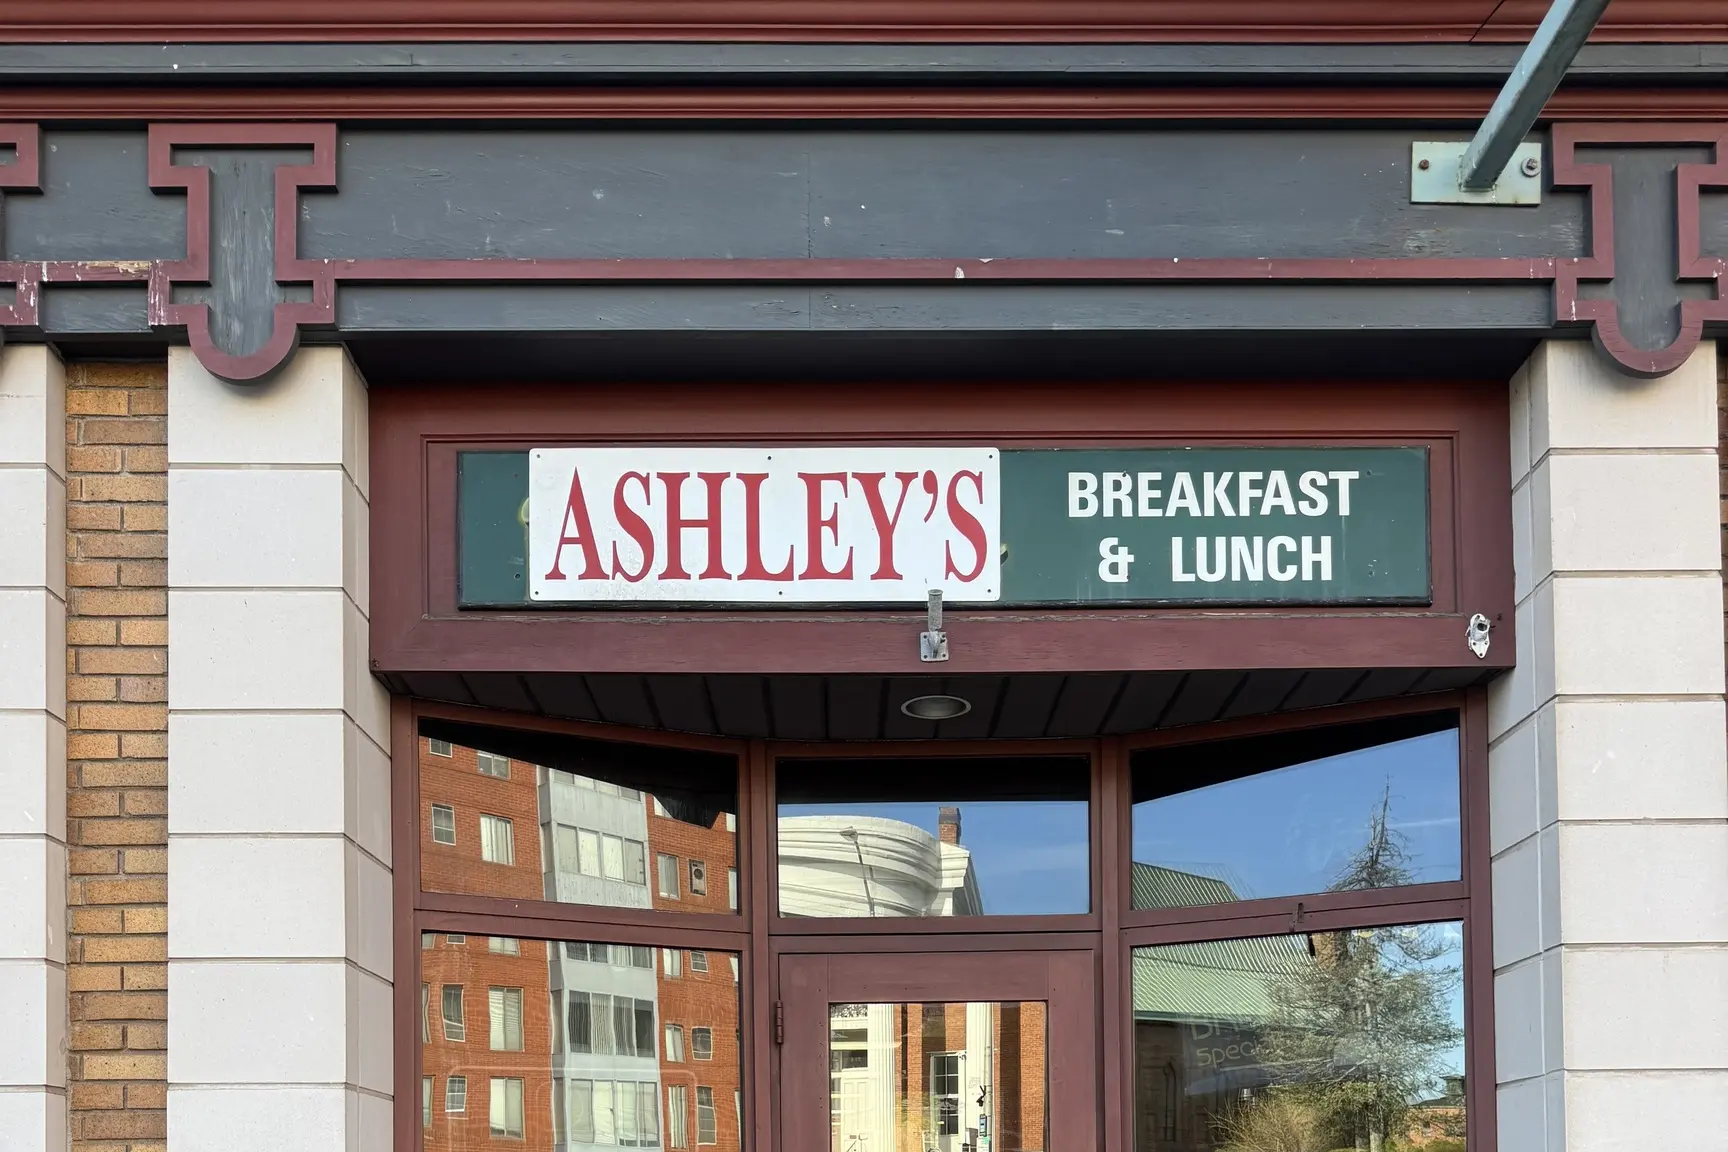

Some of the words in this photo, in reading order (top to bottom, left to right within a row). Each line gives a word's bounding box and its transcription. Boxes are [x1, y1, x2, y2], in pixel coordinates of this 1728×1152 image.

[1067, 470, 1360, 518] BREAKFAST
[545, 466, 988, 583] ASHLEY'S
[1098, 536, 1135, 583] &
[1171, 535, 1334, 582] LUNCH
